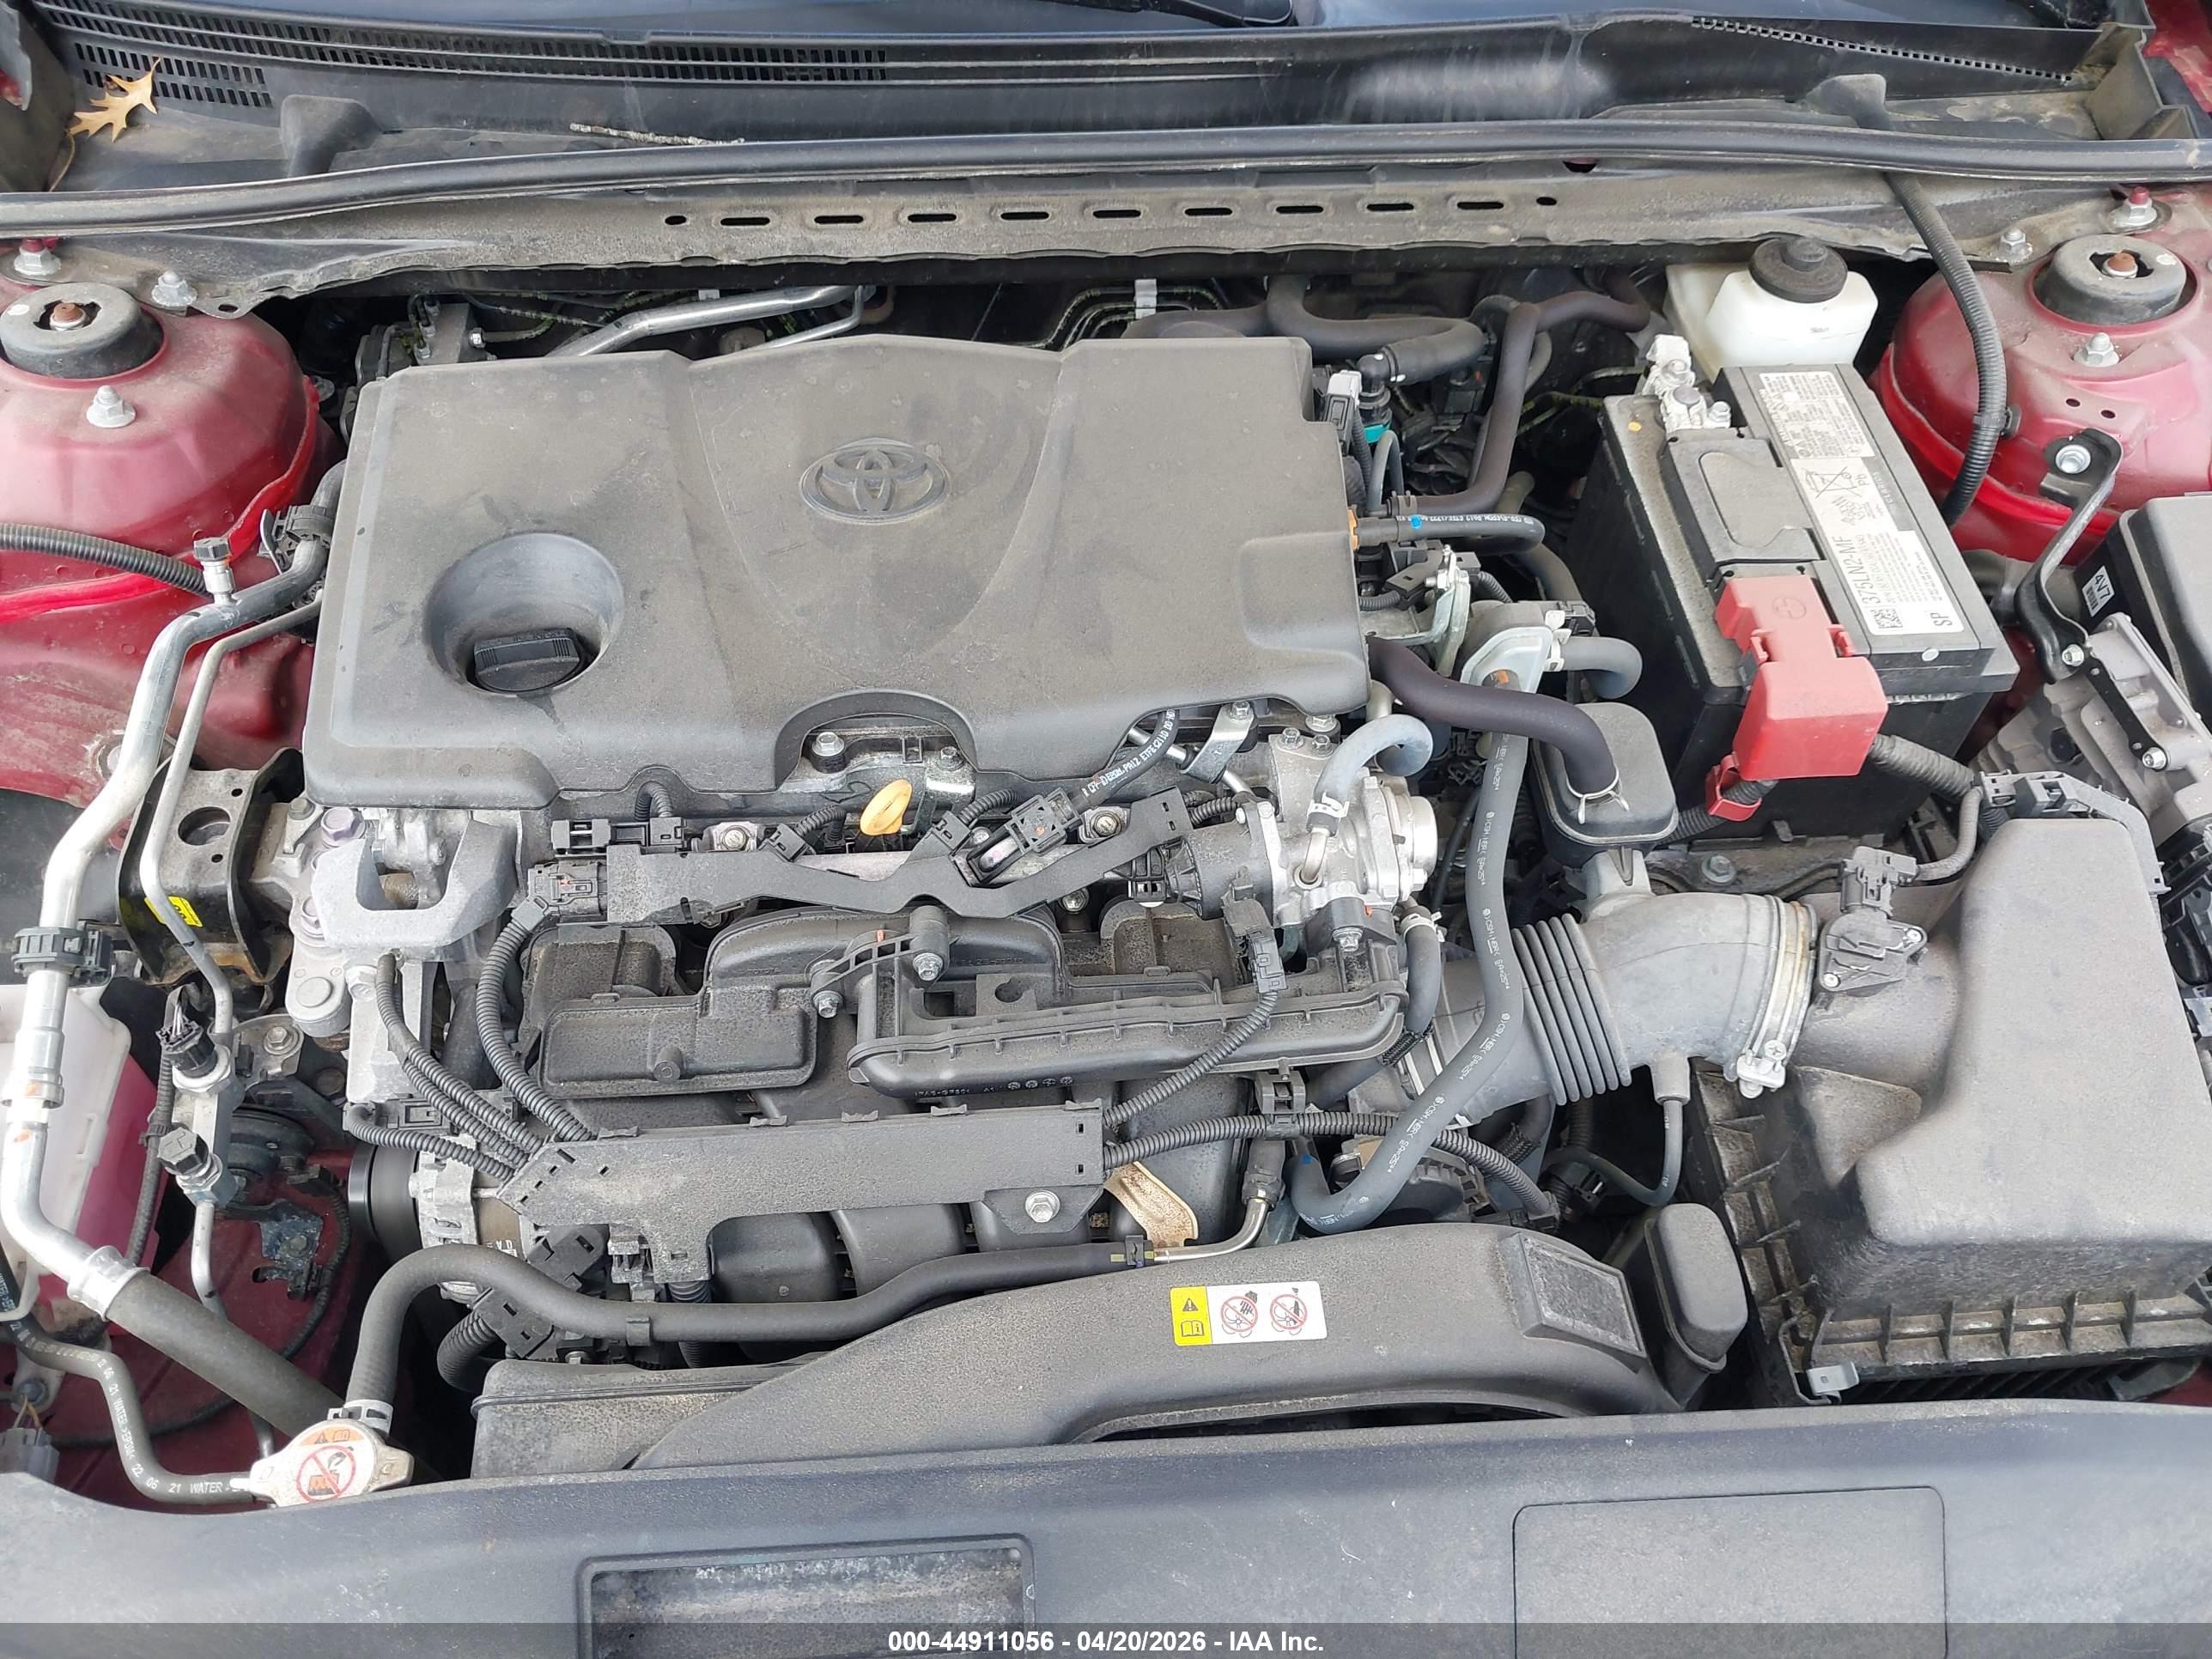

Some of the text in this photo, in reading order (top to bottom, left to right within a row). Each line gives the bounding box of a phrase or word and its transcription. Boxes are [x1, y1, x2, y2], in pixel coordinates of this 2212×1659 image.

[1855, 473, 1869, 486] Pb
[1832, 535, 1881, 605] 375LN2-MF
[2095, 574, 2111, 599] 4V7
[1929, 612, 1953, 626] SP
[109, 1383, 119, 1396] 21
[113, 1398, 129, 1428] WATER
[131, 1463, 144, 1478] 22
[146, 1476, 159, 1490] 06
[168, 1482, 182, 1494] 21
[190, 1481, 222, 1494] WATER
